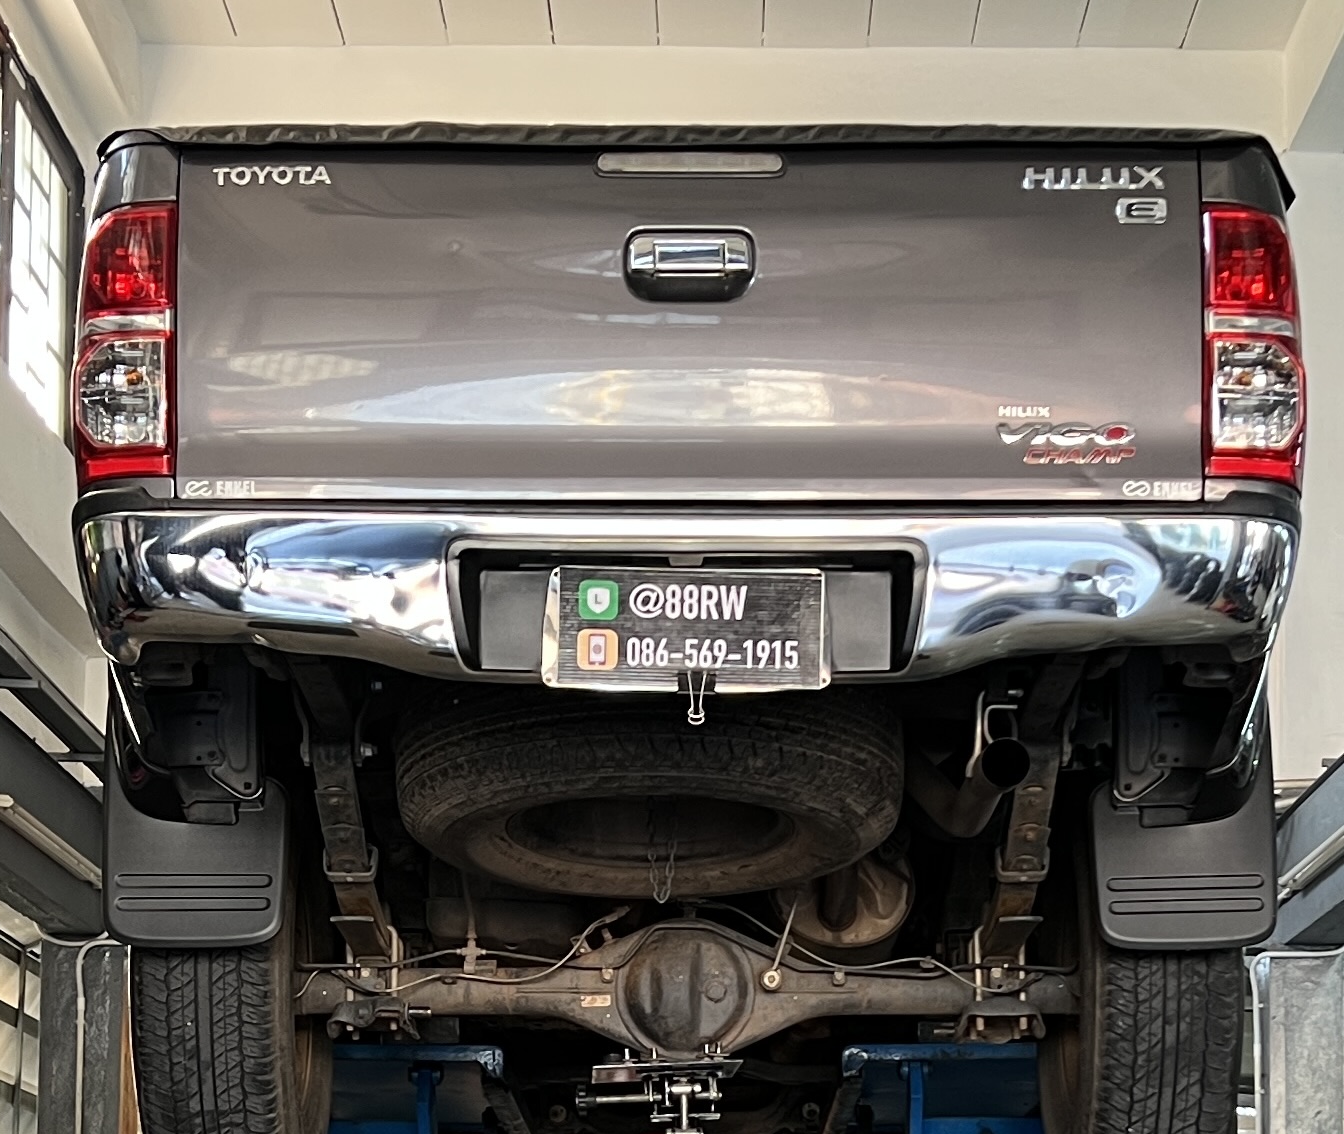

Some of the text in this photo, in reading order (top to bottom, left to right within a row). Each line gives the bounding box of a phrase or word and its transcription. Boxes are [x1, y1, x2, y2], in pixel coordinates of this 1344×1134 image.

[212, 165, 332, 186] TOYOTA
[1022, 165, 1165, 190] HILUX
[998, 406, 1050, 418] HILUX
[996, 421, 1137, 447] VIGO
[1023, 447, 1136, 465] CHAMP
[629, 583, 749, 621] @88RW
[625, 637, 800, 670] 086-569-1915
